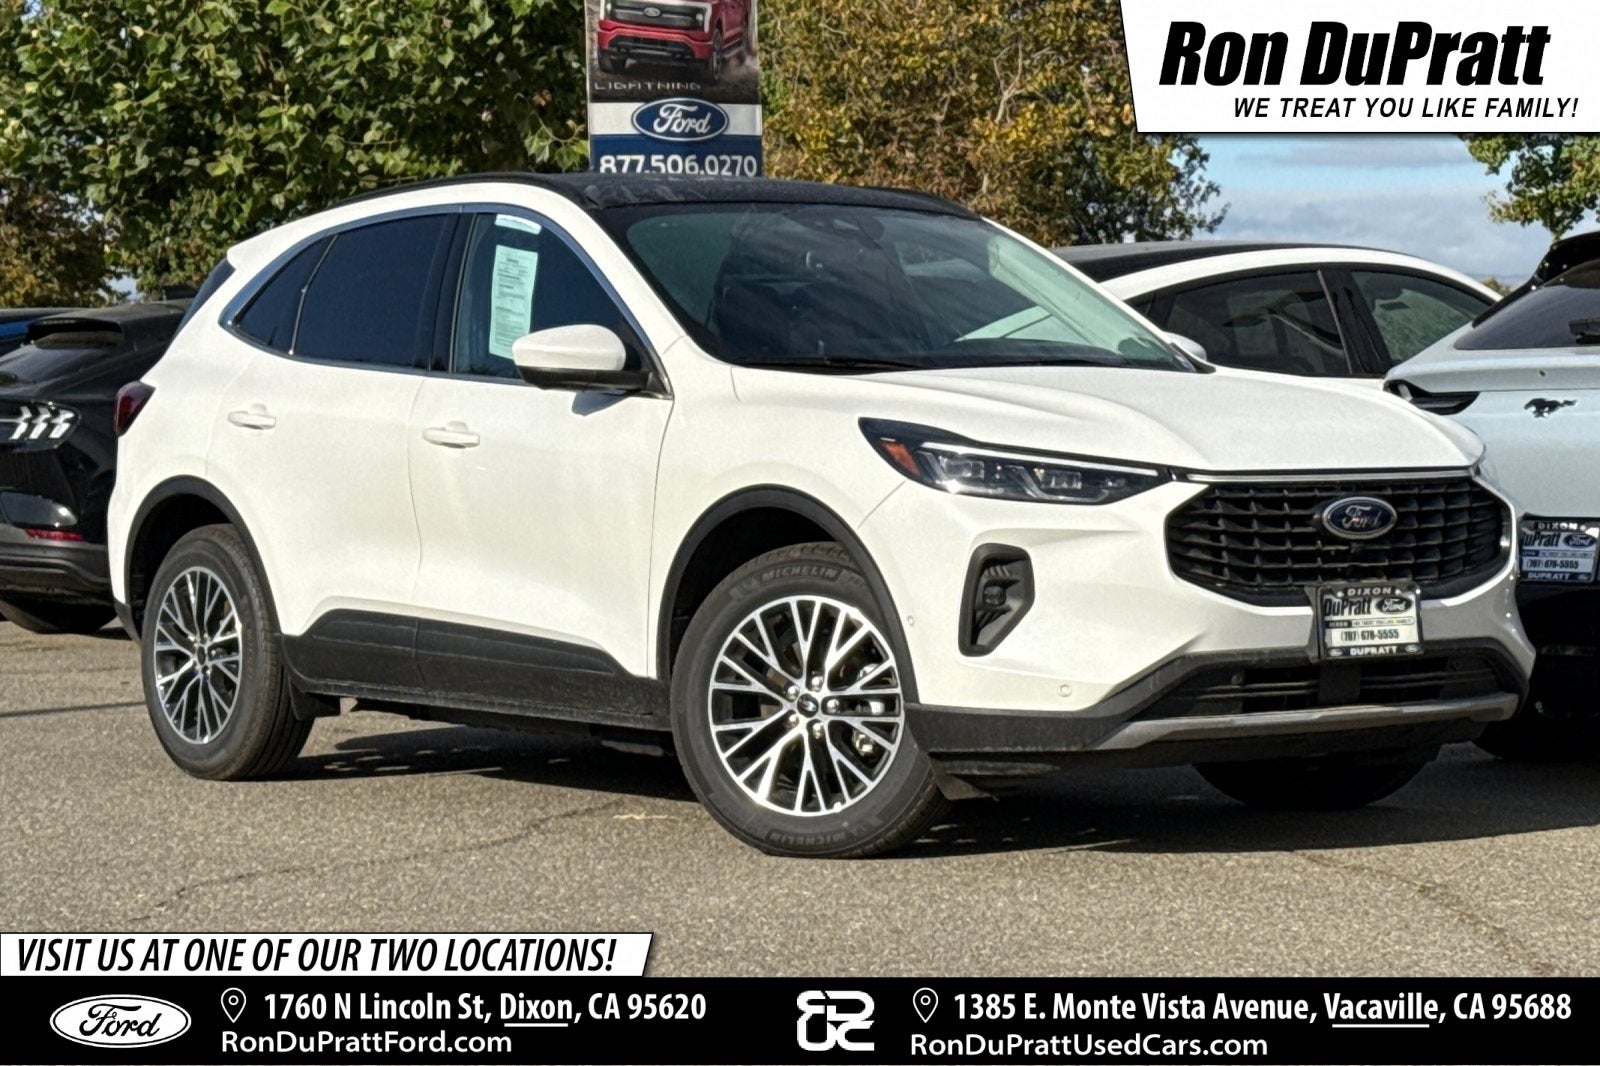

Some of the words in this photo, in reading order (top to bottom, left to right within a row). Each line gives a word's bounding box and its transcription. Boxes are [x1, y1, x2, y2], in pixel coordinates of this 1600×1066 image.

[653, 103, 712, 134] Ford
[599, 154, 758, 177] 877.506.0270
[1342, 505, 1382, 529] Ford
[762, 565, 838, 582] MICHELIN
[1347, 586, 1392, 596] DIXON
[1350, 645, 1398, 656] DUPRATT
